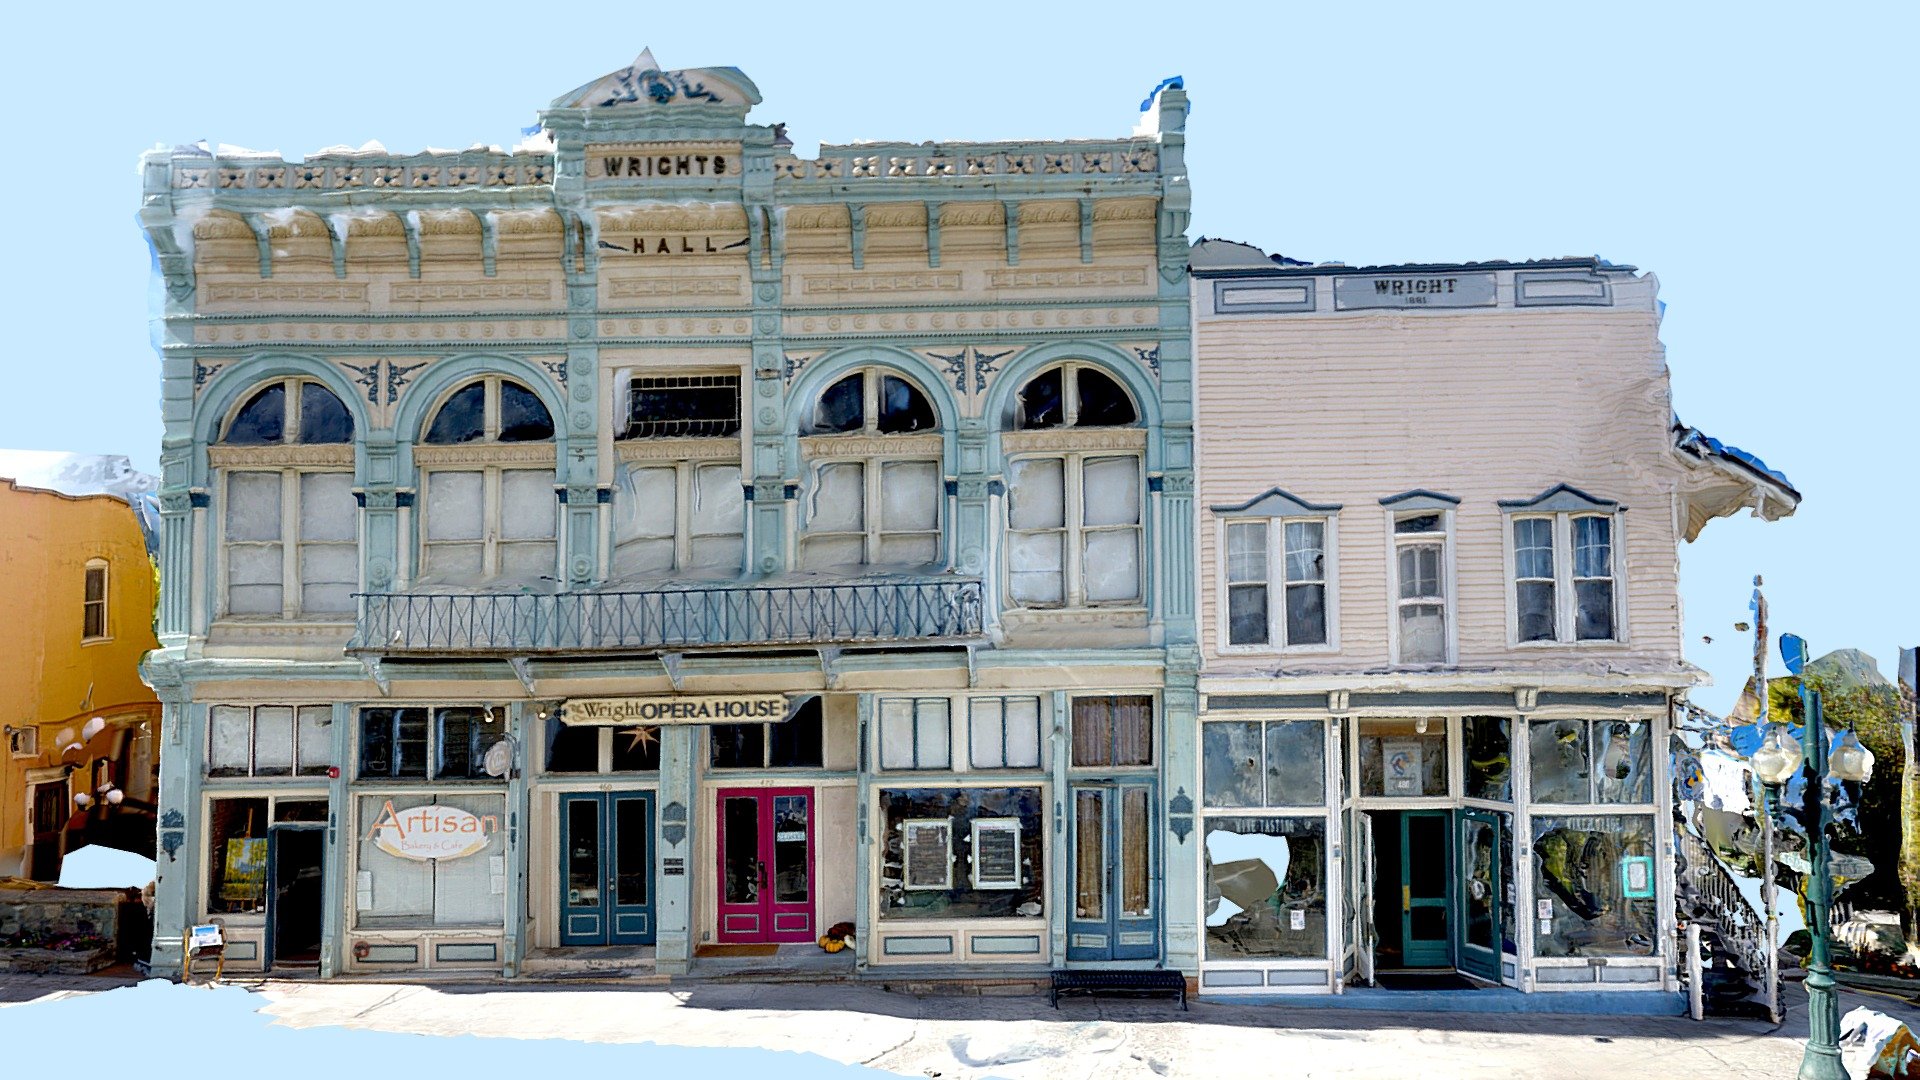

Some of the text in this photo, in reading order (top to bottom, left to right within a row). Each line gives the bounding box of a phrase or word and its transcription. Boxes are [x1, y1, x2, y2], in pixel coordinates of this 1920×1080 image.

[604, 155, 726, 177] WRIGHTS
[633, 236, 717, 254] HALL
[1373, 278, 1458, 296] WRIGHT
[584, 701, 640, 722] Wright
[640, 701, 711, 720] OPERA
[715, 700, 781, 717] HOUSE
[365, 800, 498, 841] Artisan
[1260, 818, 1294, 833] TASTING
[401, 840, 433, 852] Bakery
